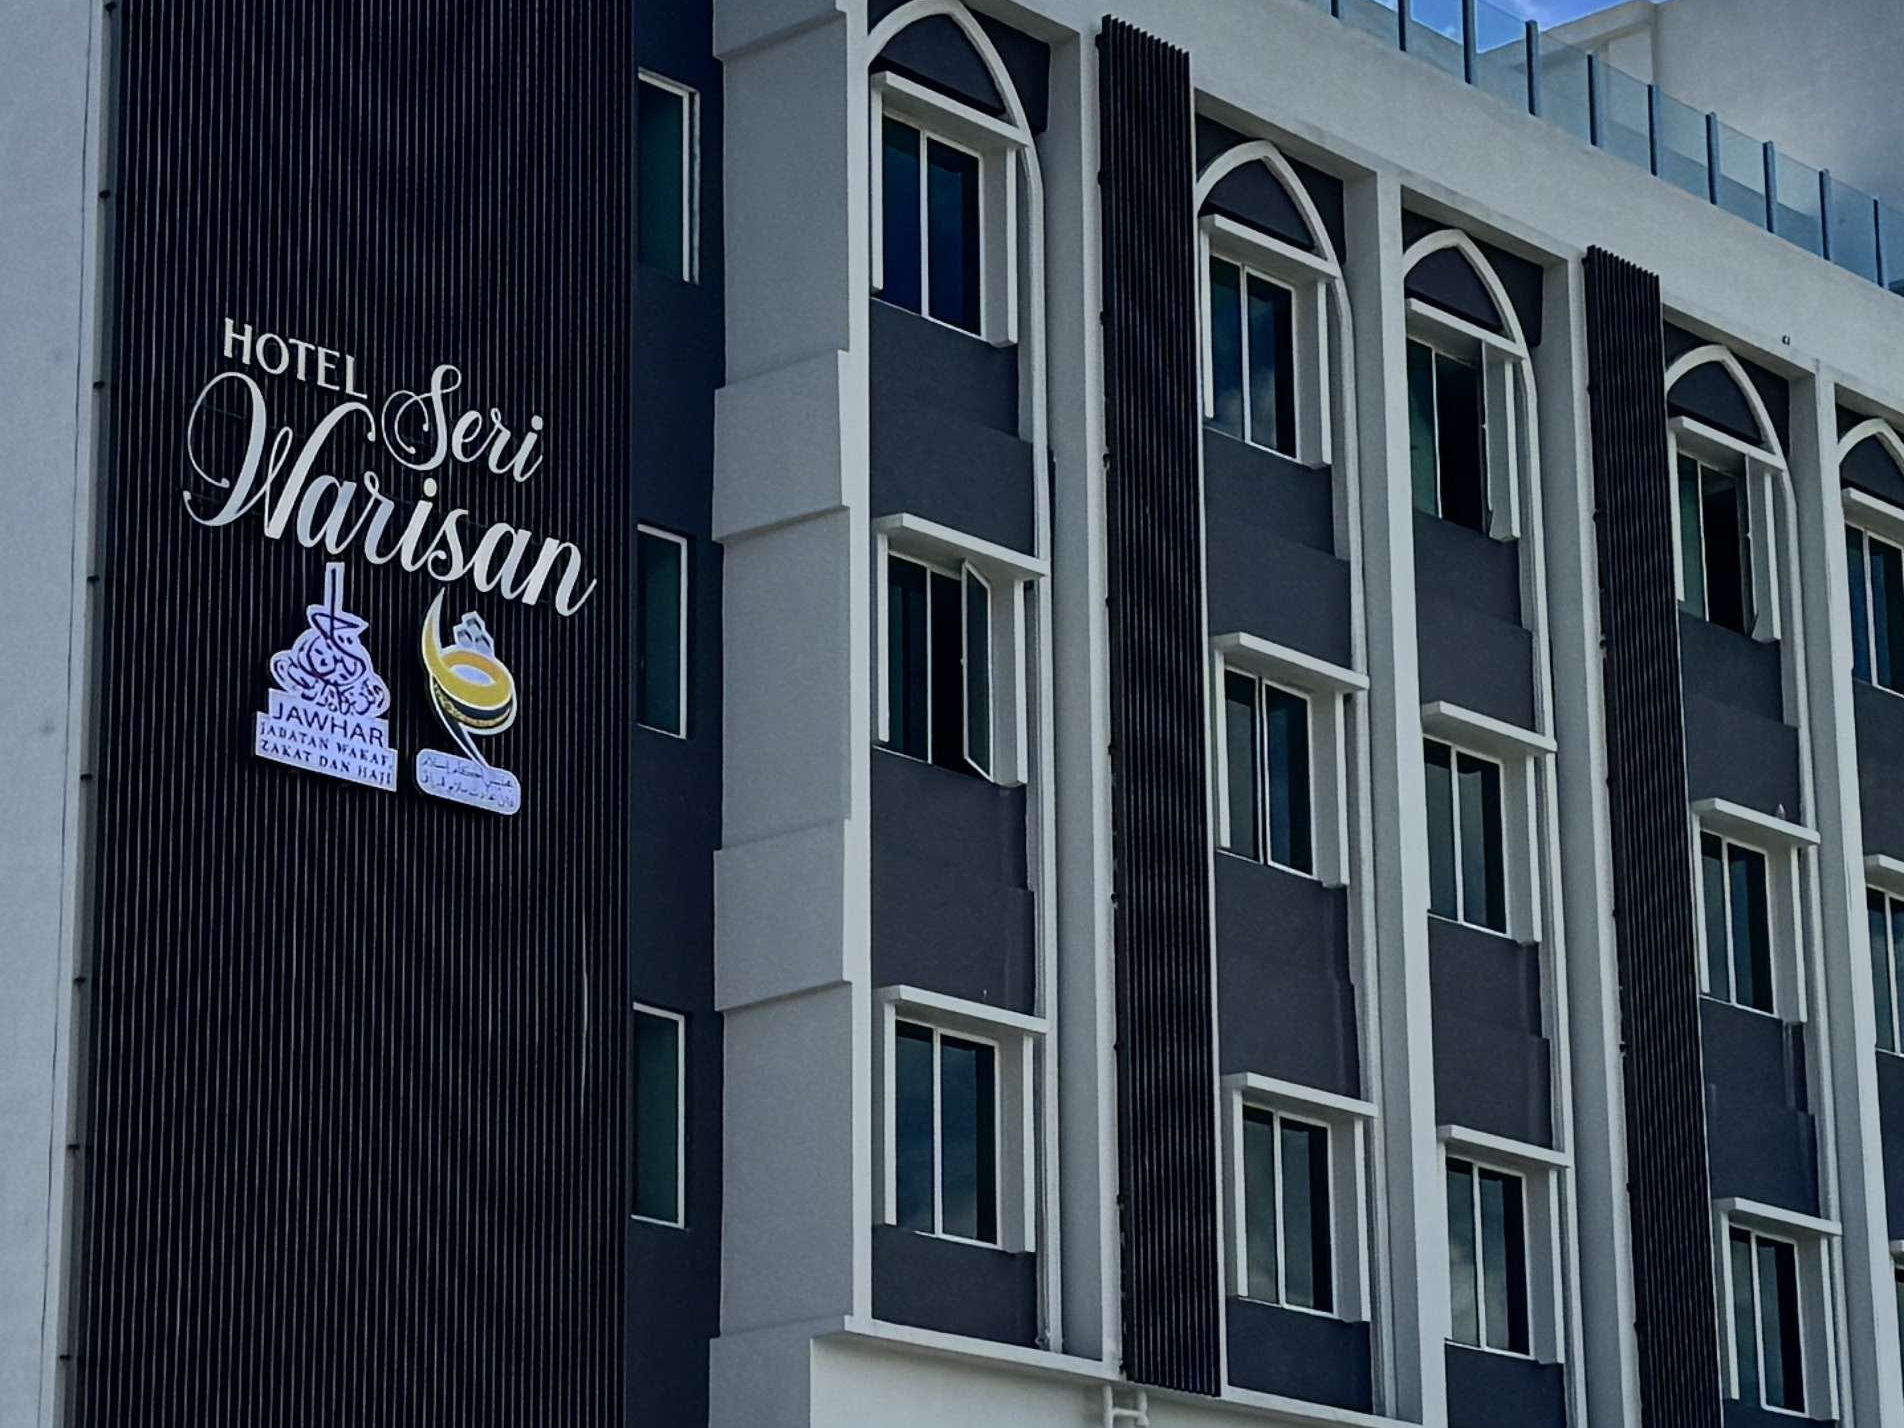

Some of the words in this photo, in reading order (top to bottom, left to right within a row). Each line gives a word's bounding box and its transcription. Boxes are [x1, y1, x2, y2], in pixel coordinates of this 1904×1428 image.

[223, 317, 368, 400] HOTEL
[382, 363, 544, 483] Seri
[182, 371, 597, 617] Warisan
[259, 721, 330, 751] JABATAN
[272, 701, 384, 749] JAWHAR
[260, 738, 313, 763] ZAKAT
[318, 754, 351, 773] DAN
[357, 764, 392, 786] HAJI
